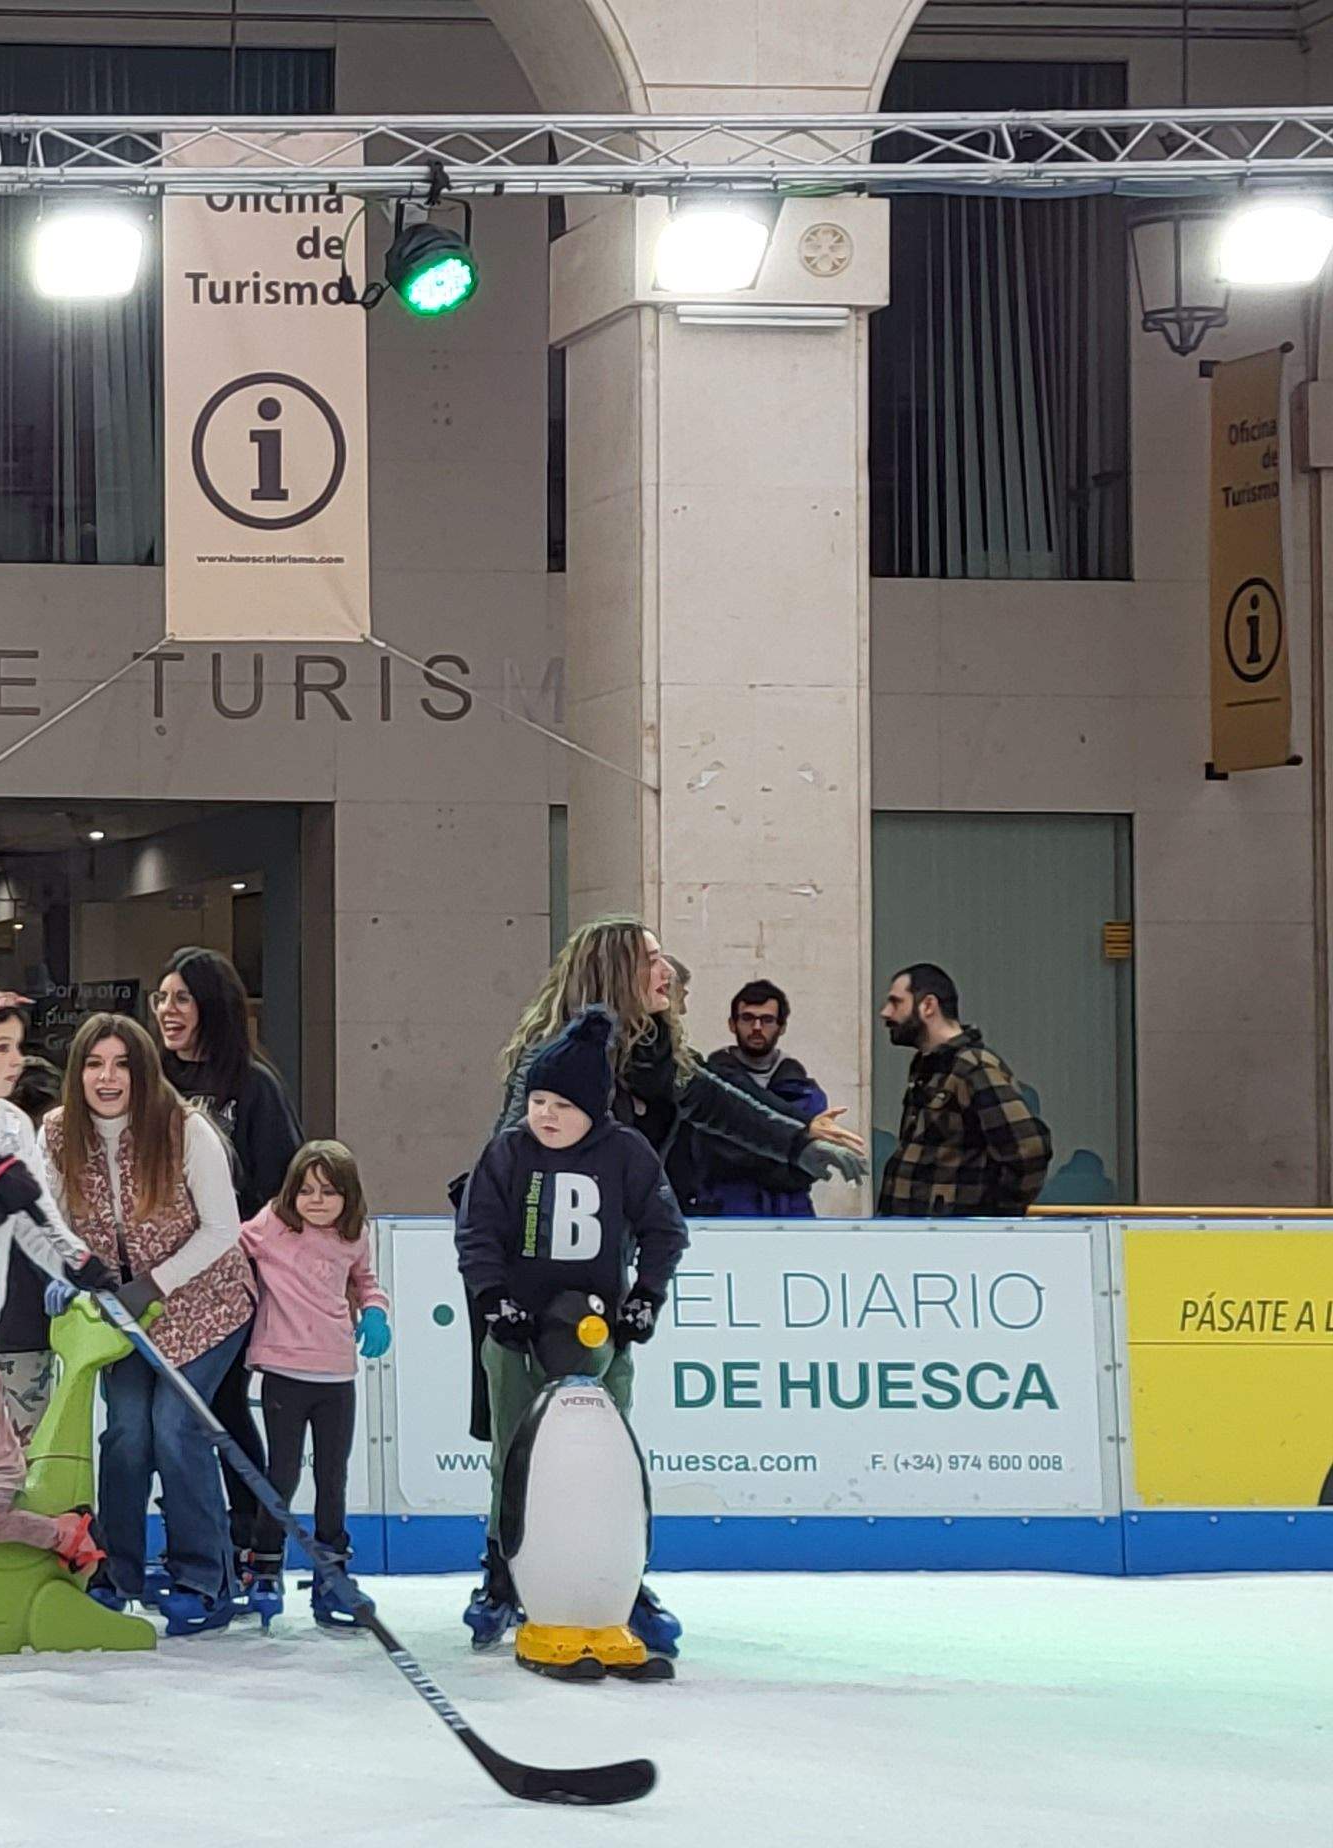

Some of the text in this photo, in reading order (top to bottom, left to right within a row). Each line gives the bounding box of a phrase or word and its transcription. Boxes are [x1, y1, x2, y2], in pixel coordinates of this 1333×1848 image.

[296, 226, 345, 260] de
[185, 271, 343, 306] Turismo
[195, 552, 345, 566] www.huescaturismo.com
[550, 1172, 603, 1261] B
[673, 1271, 1046, 1330] EL DIARIO
[1179, 1290, 1289, 1333] PÁSATE
[1294, 1300, 1316, 1333] A
[672, 1361, 1061, 1411] DE HUESCA
[893, 1453, 943, 1474] (+34)
[947, 1454, 983, 1472] 974
[987, 1454, 1023, 1472] 600
[1027, 1454, 1064, 1472] 008
